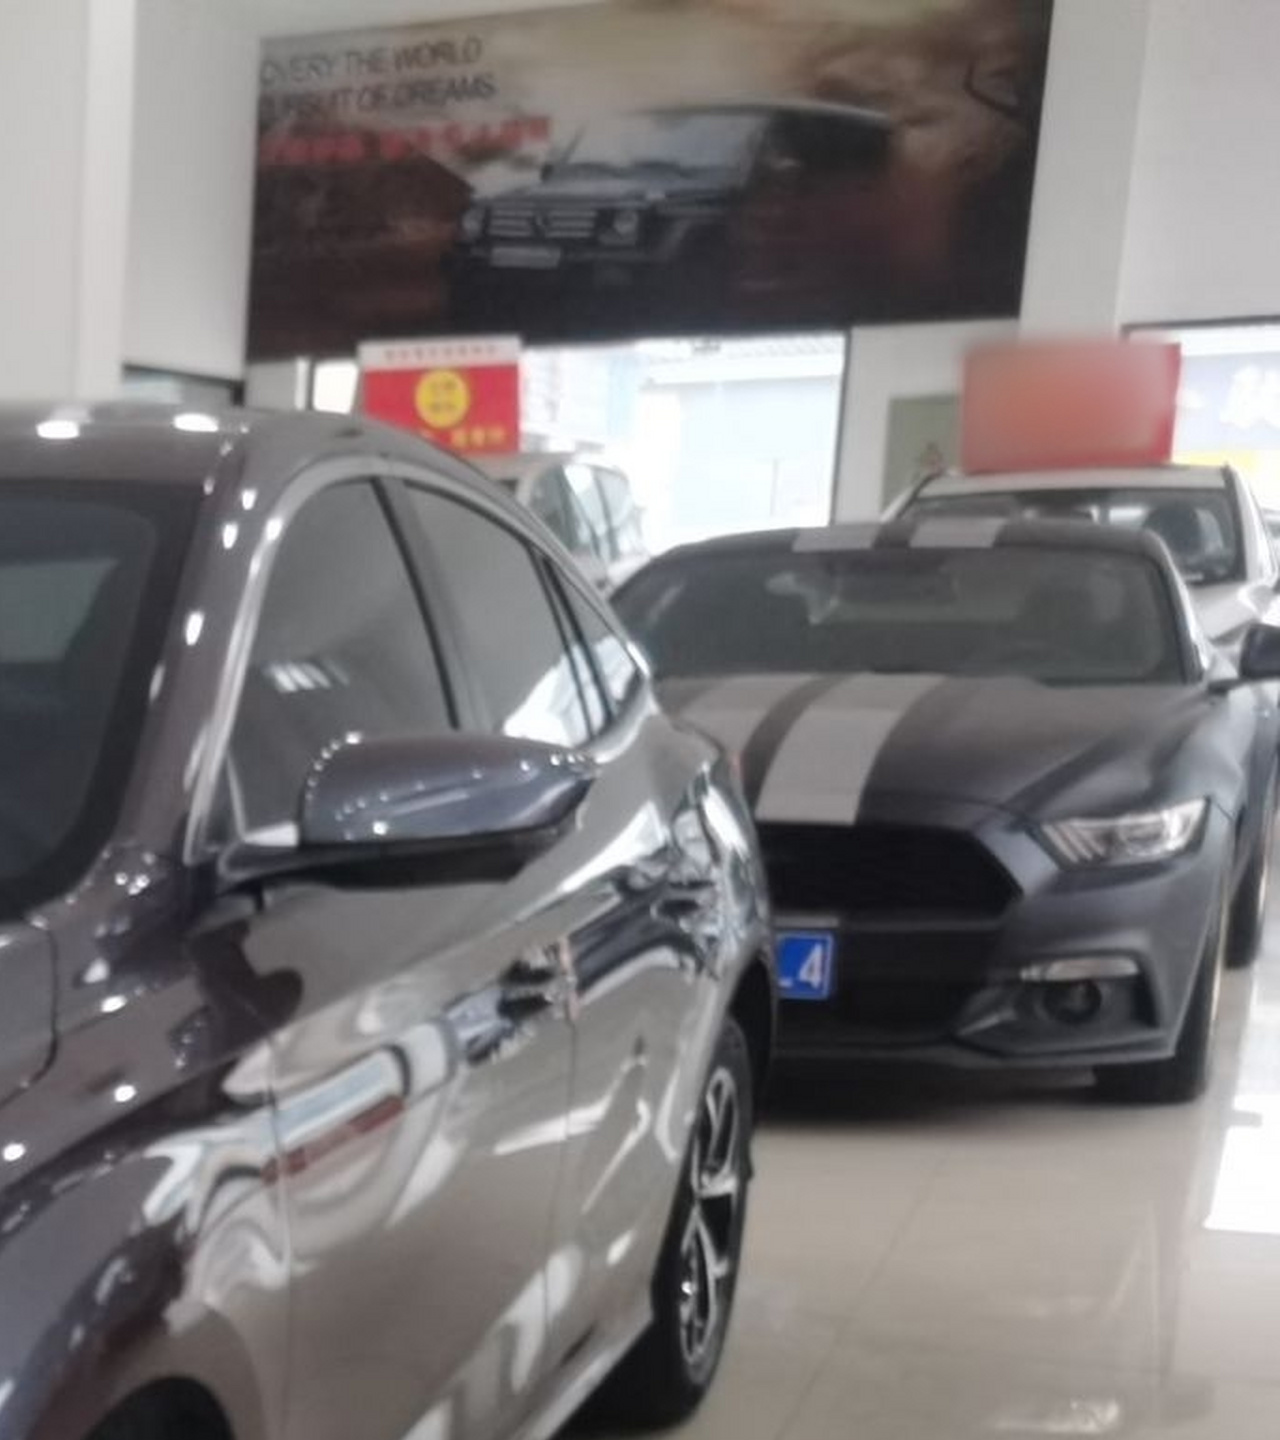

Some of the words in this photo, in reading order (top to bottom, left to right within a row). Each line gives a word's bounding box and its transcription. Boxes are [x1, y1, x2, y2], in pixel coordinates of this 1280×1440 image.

[345, 47, 389, 75] THE
[394, 35, 483, 71] WORLD
[357, 84, 387, 112] OF
[393, 72, 497, 108] DREAMS
